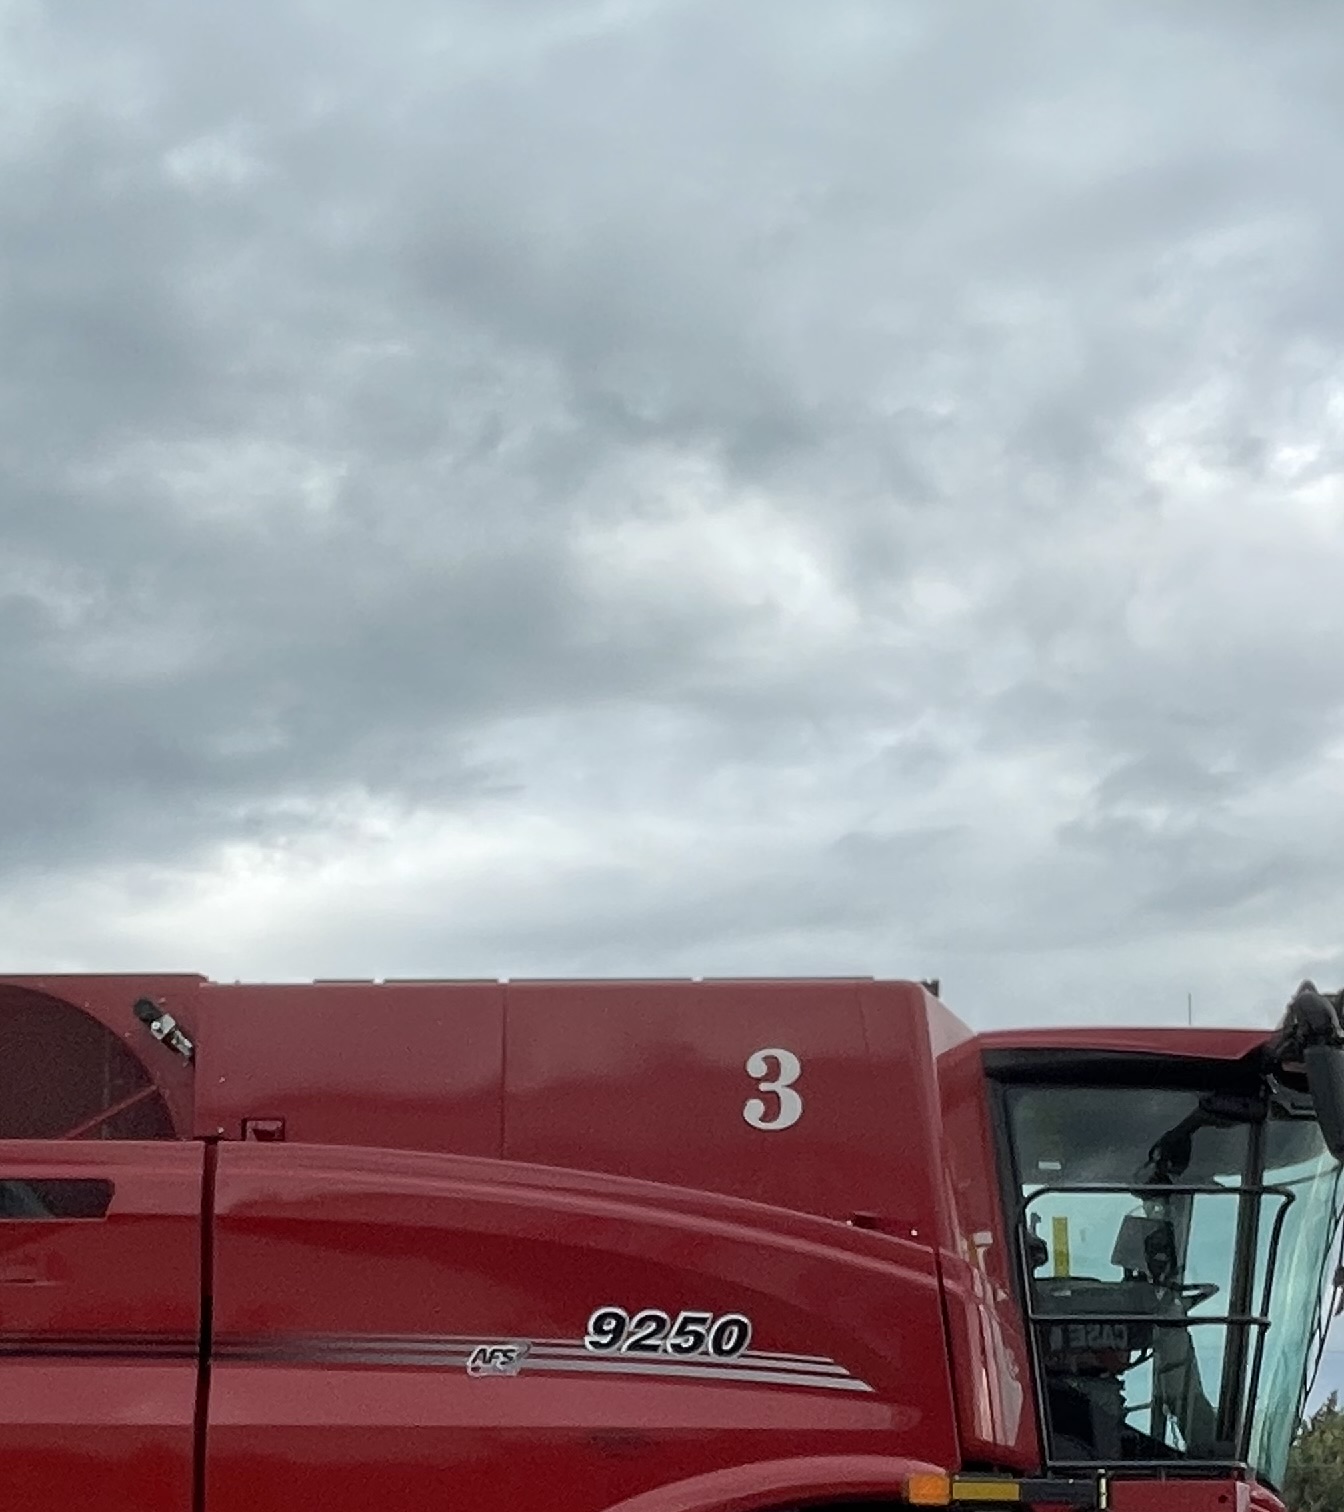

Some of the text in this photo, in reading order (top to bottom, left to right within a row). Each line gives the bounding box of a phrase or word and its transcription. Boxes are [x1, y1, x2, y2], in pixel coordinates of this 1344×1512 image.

[743, 1048, 802, 1130] 3
[468, 1345, 519, 1368] AFS
[585, 1307, 752, 1360] 9250
